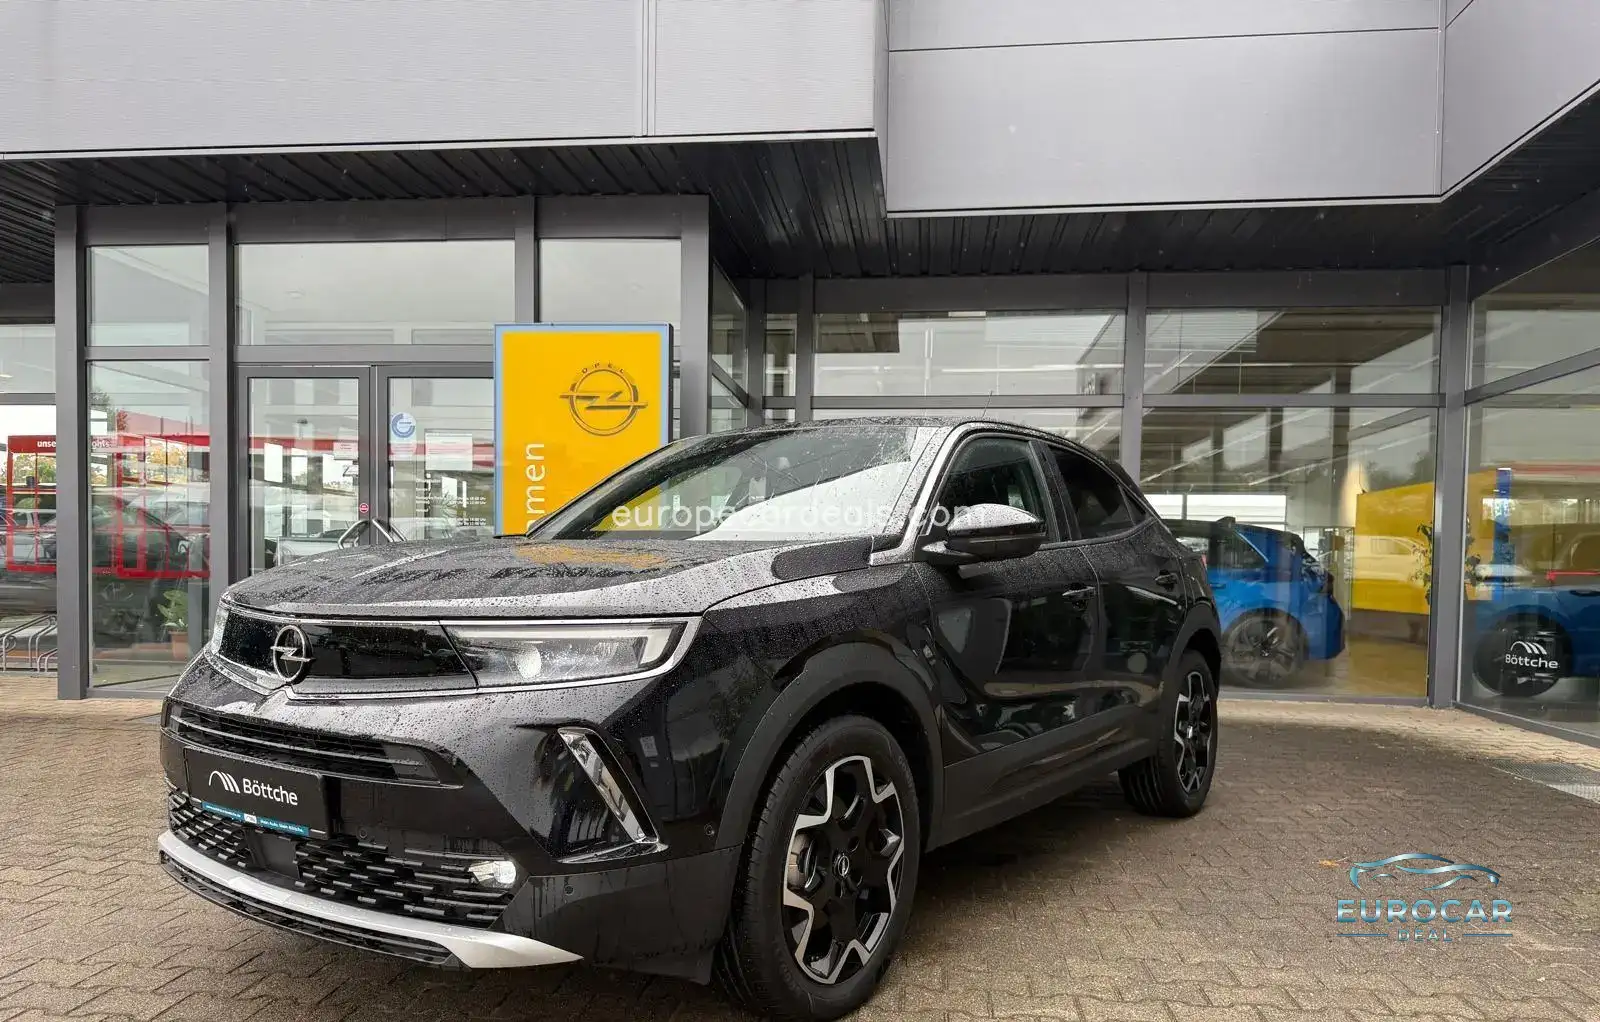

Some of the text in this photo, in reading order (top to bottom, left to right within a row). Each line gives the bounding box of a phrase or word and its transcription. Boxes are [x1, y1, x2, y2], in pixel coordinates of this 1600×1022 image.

[581, 360, 625, 374] OPEL
[1505, 653, 1559, 669] Böttche
[242, 777, 299, 806] Böttche
